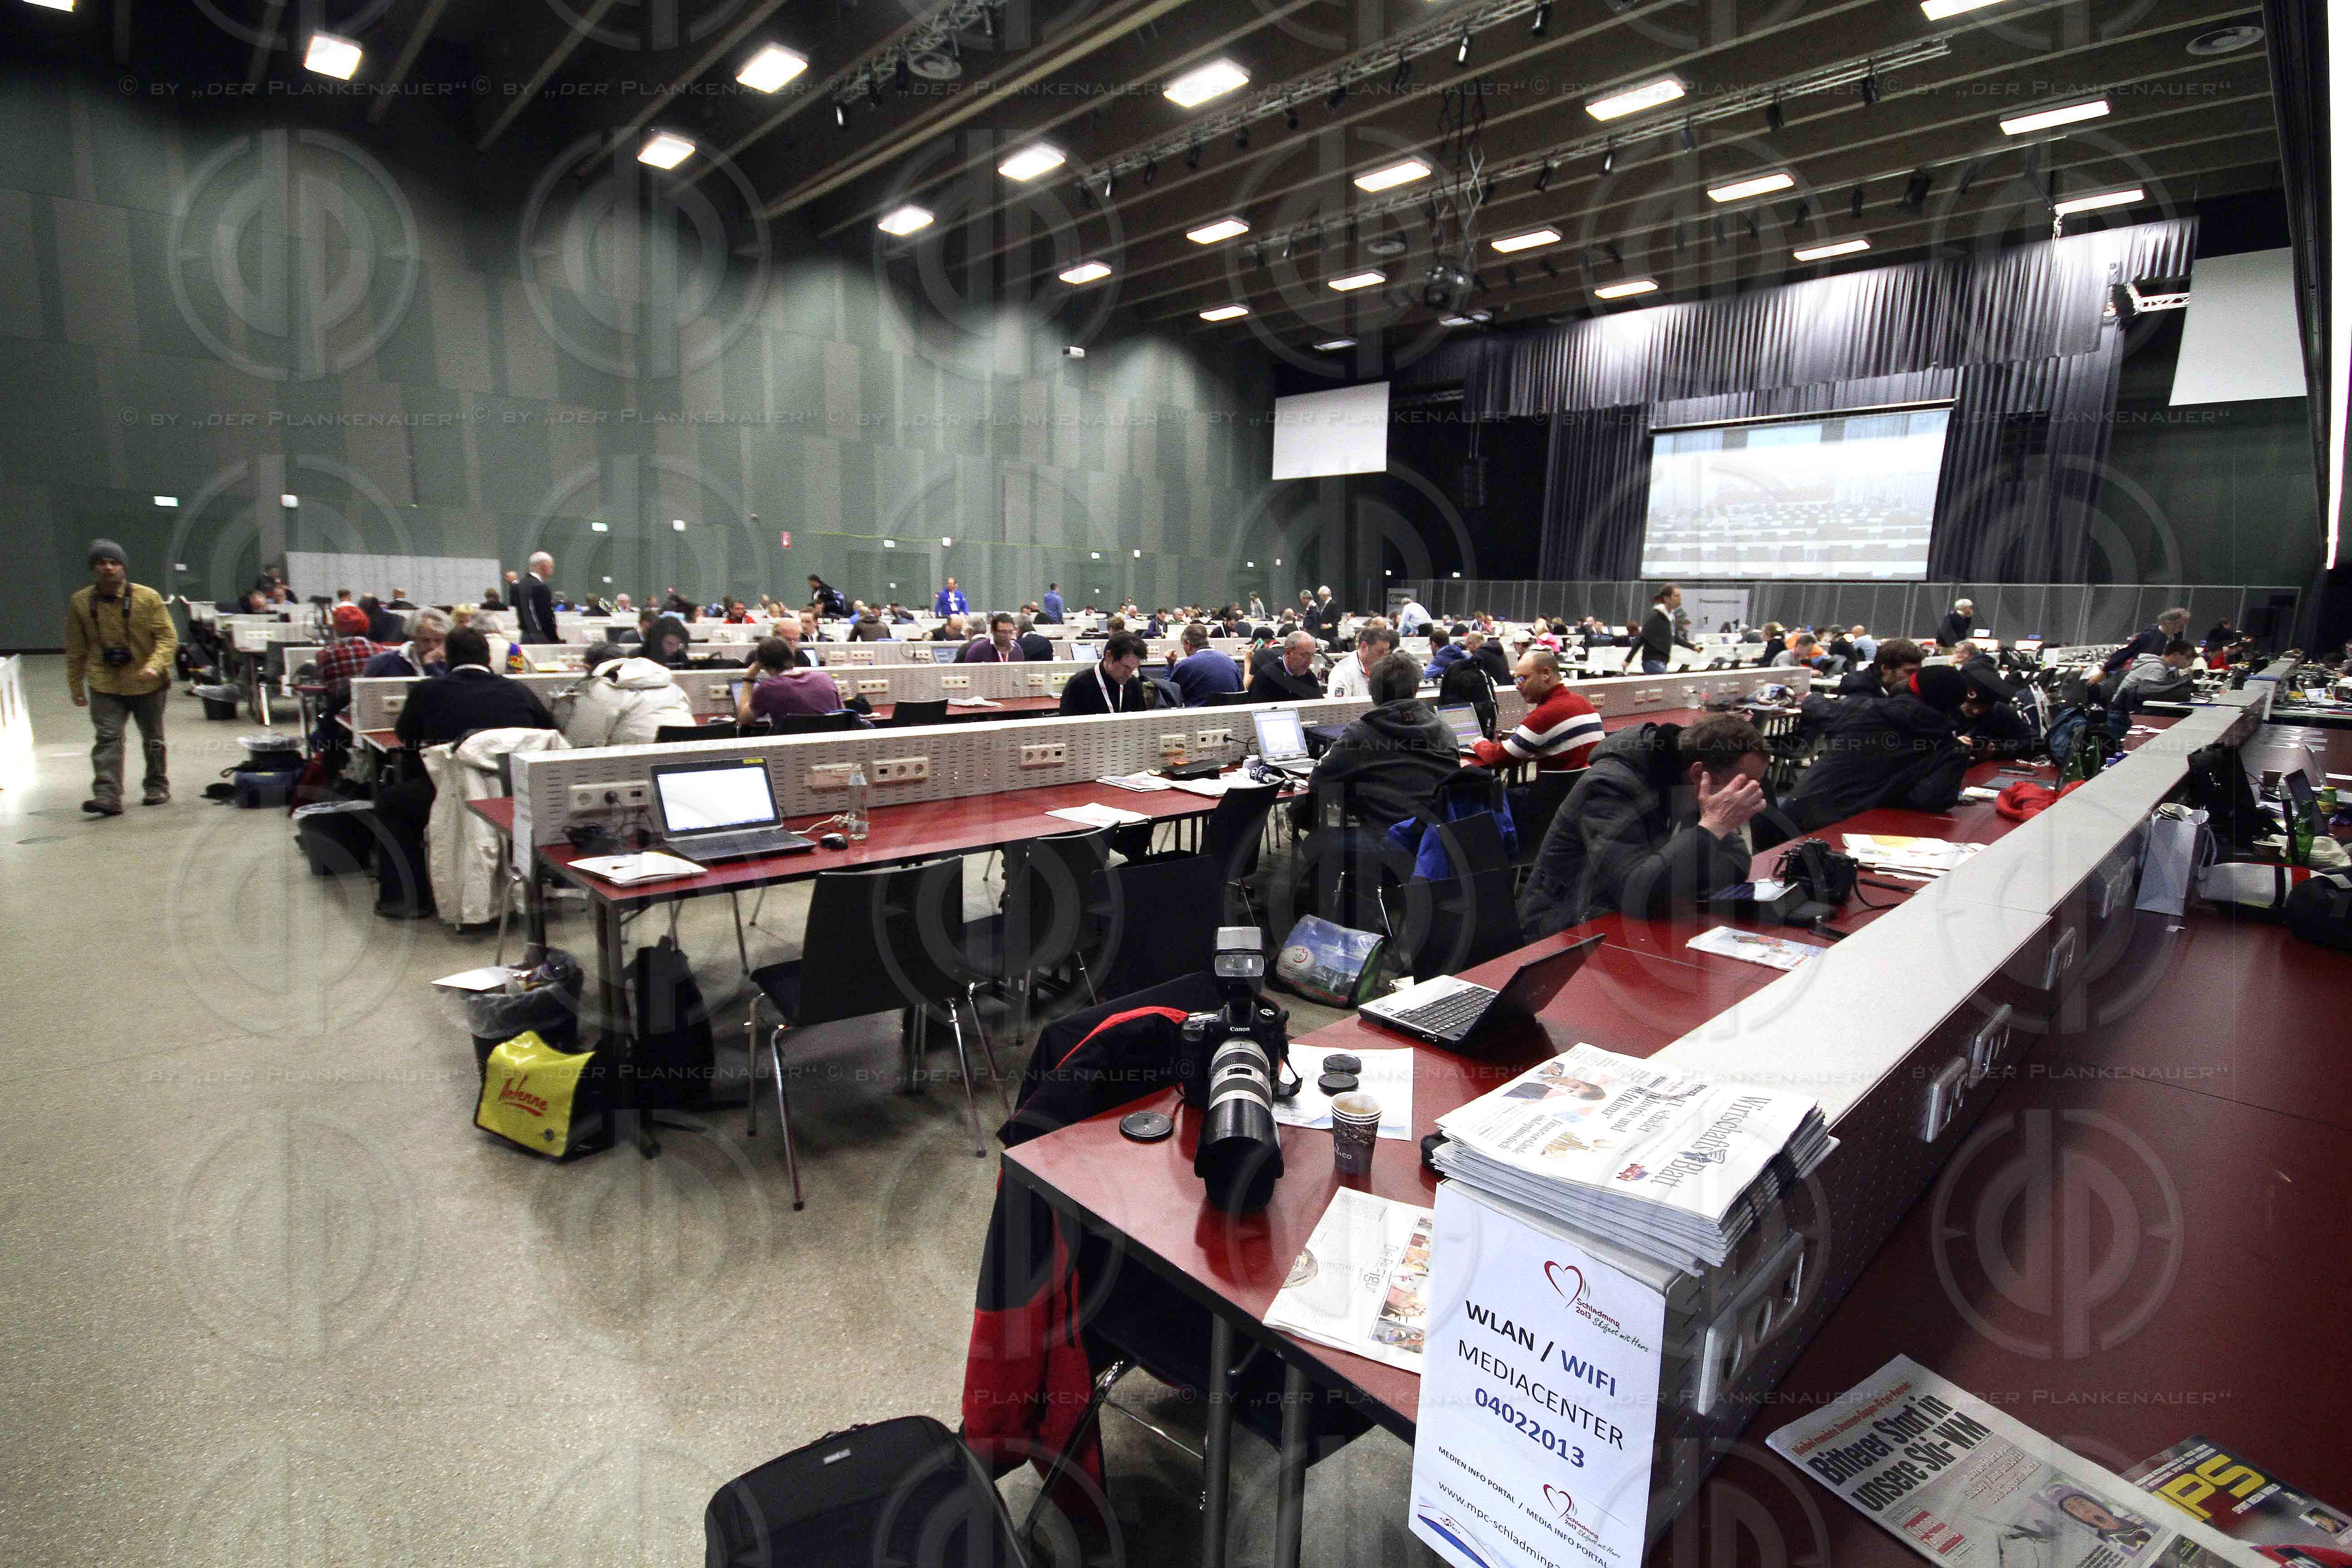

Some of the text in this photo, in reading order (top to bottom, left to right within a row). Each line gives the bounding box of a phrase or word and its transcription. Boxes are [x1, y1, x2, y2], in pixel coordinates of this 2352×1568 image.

[1650, 1096, 1772, 1188] Wirtschafts Blatt
[1466, 1299, 1616, 1397] WLAN / WIFI
[1575, 1306, 1649, 1353] 2013 Skifest mit Herz
[1576, 1298, 1621, 1329] Schladming
[1458, 1339, 1623, 1450] MEDIACENTER
[1475, 1387, 1585, 1468] 04022013
[1807, 1394, 1954, 1486] Bitterer Start in
[1438, 1446, 1467, 1470] MEDIEN
[1468, 1465, 1486, 1482] INFO
[1488, 1480, 1515, 1504] PORTAL
[1526, 1507, 1553, 1530] MEDIA
[1554, 1527, 1574, 1546] INFO
[1576, 1542, 1608, 1568] PORTAL
[1850, 1411, 1992, 1513] unsere Ski-WM
[1565, 1514, 1599, 1540] Schladming
